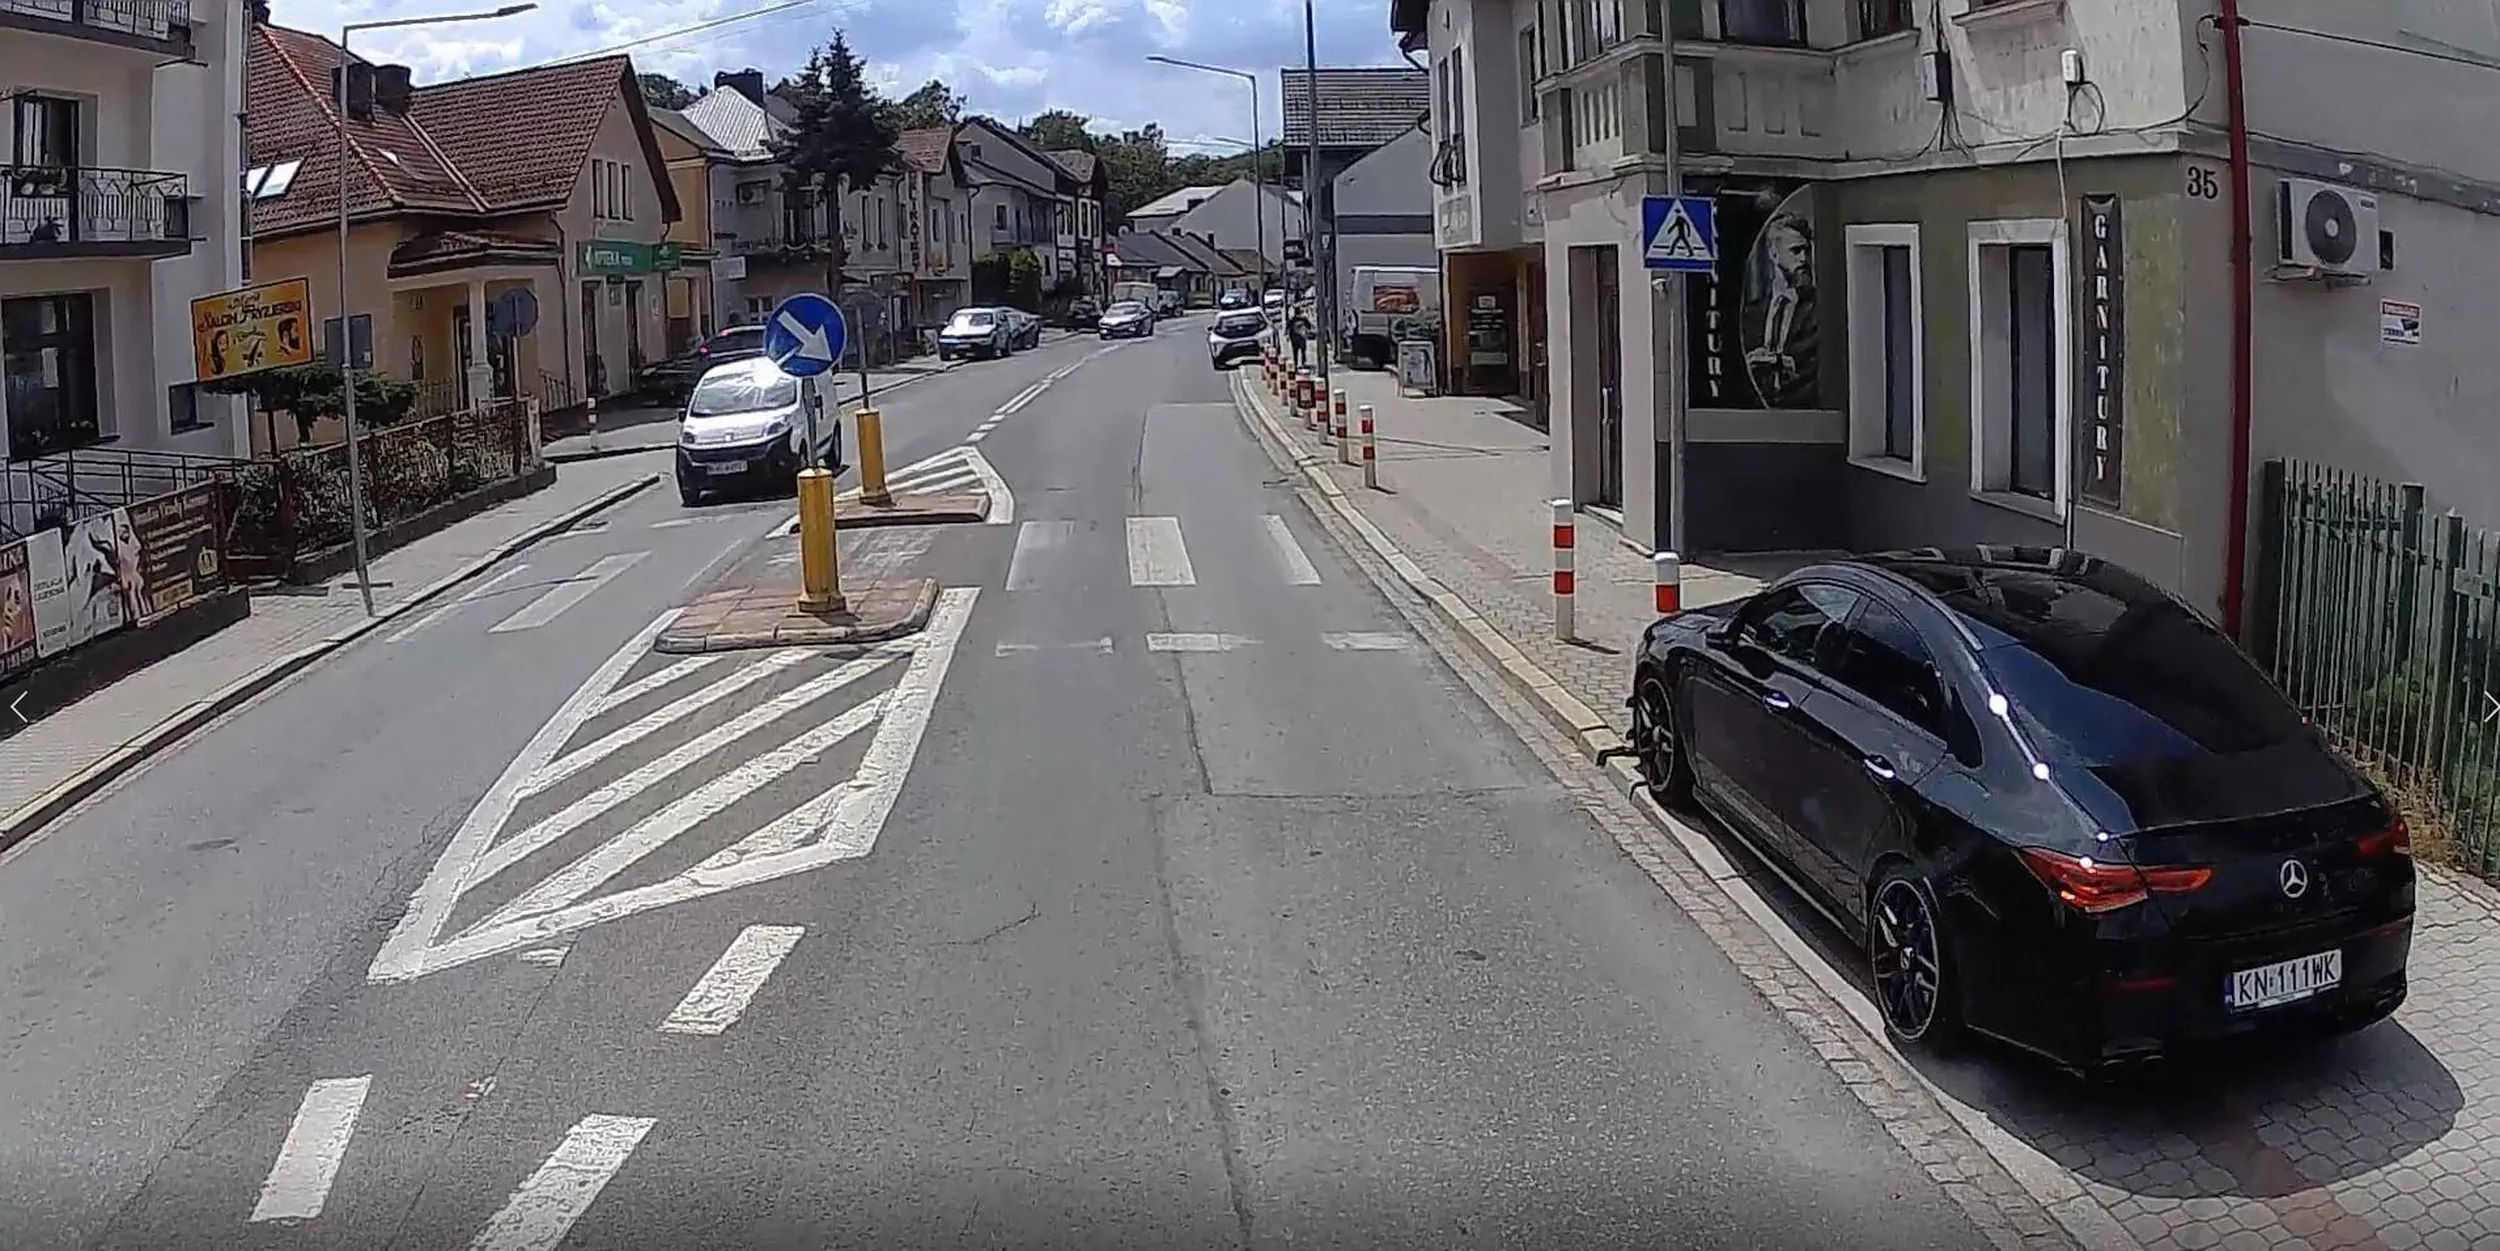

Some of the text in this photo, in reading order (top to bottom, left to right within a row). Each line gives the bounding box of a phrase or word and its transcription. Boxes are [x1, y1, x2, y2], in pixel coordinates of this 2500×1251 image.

[2187, 166, 2218, 199] 35
[2094, 214, 2109, 480] GARNITURY
[2239, 953, 2336, 1003] KN 111WK
